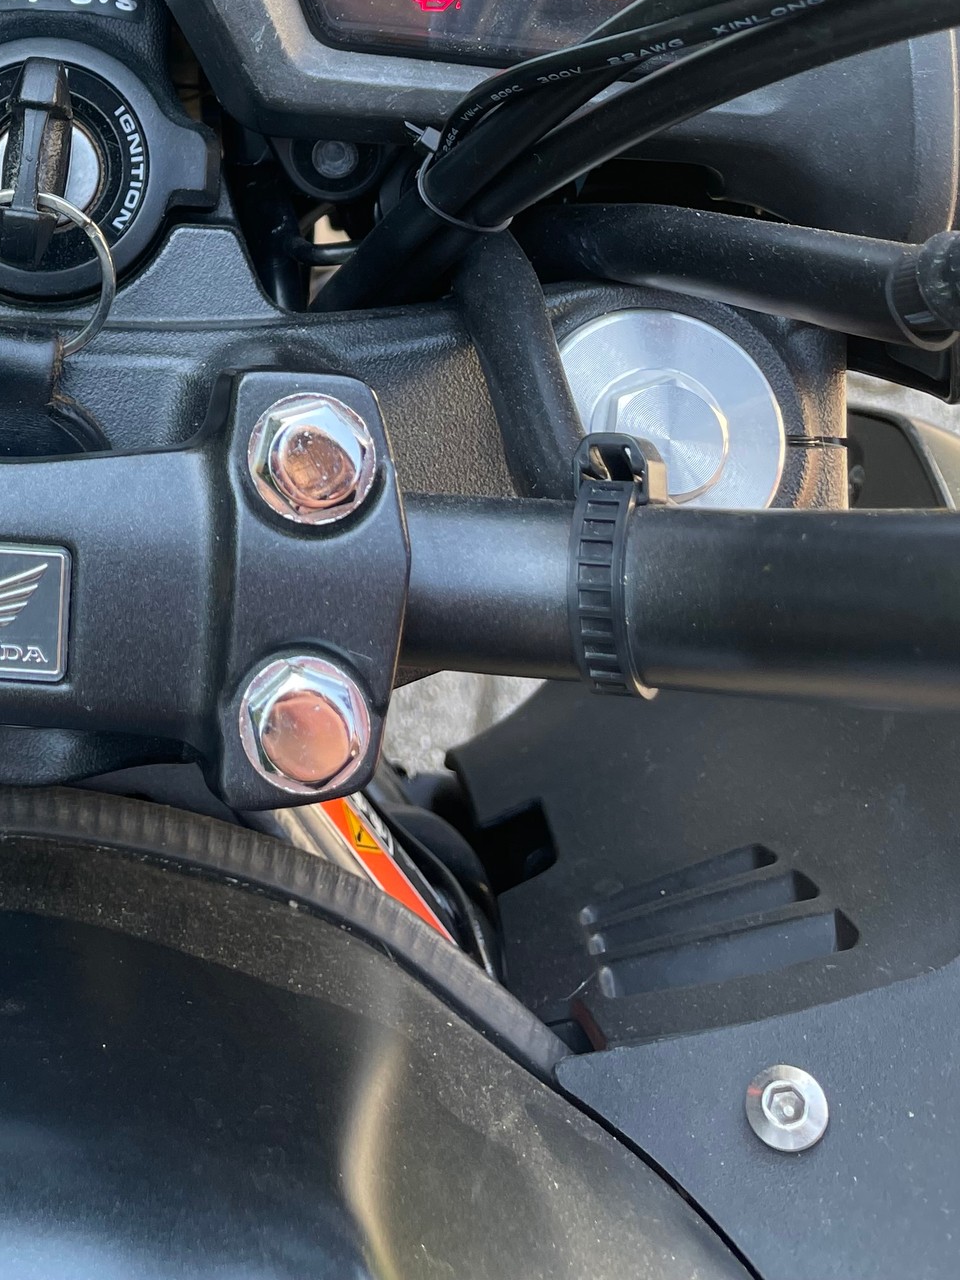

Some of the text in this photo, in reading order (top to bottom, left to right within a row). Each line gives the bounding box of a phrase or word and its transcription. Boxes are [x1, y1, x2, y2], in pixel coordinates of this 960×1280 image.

[537, 66, 582, 84] 300V
[606, 38, 685, 65] 22AWG
[113, 105, 145, 230] IGNITION
